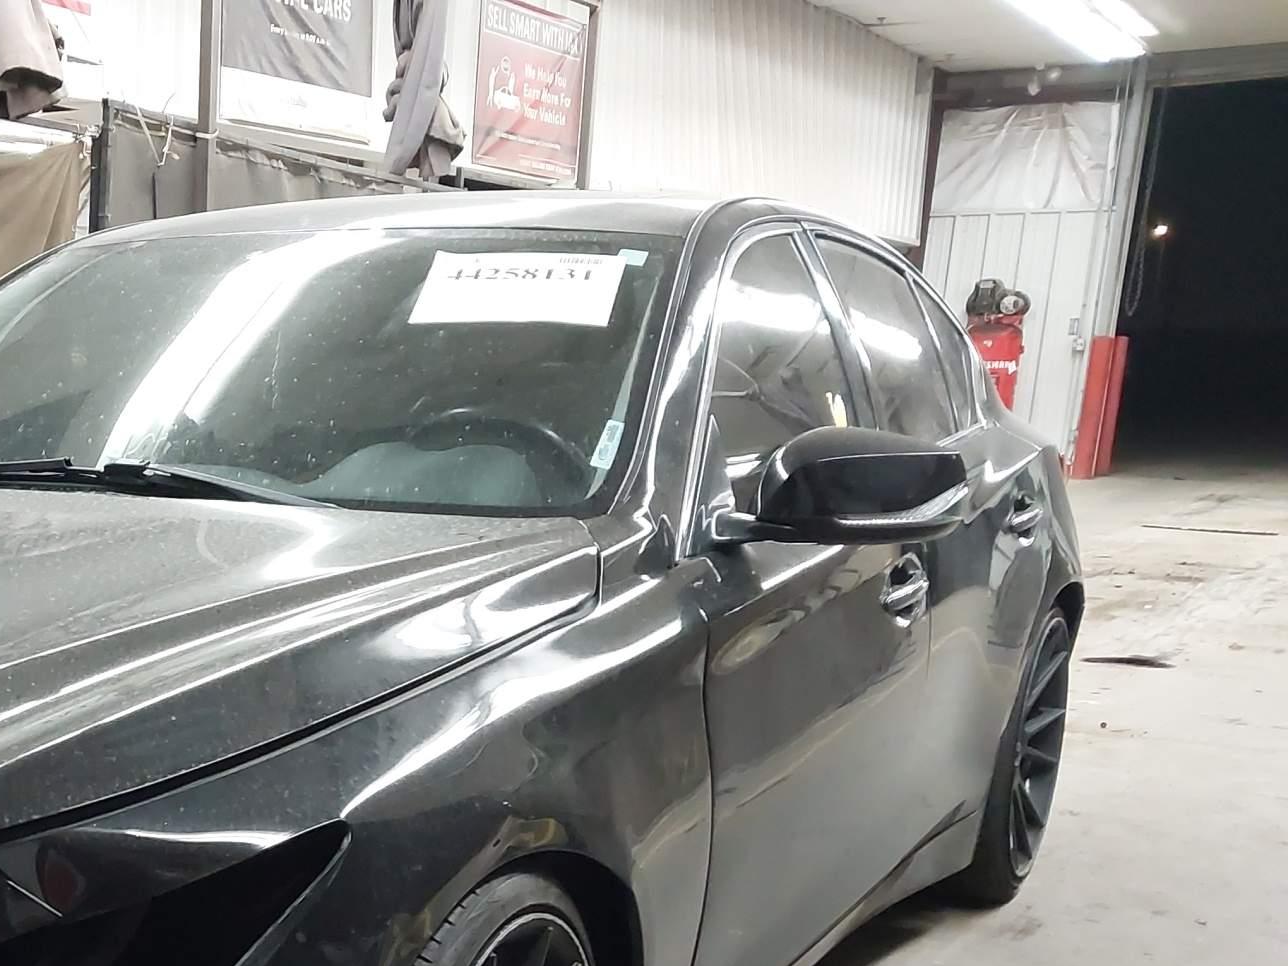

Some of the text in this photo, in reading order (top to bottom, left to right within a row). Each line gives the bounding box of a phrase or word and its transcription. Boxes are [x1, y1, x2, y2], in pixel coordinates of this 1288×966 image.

[313, 0, 352, 22] CARS
[487, 4, 507, 31] SELL
[510, 12, 541, 42] SMART
[542, 22, 564, 51] WITH
[447, 267, 592, 280] 44258131
